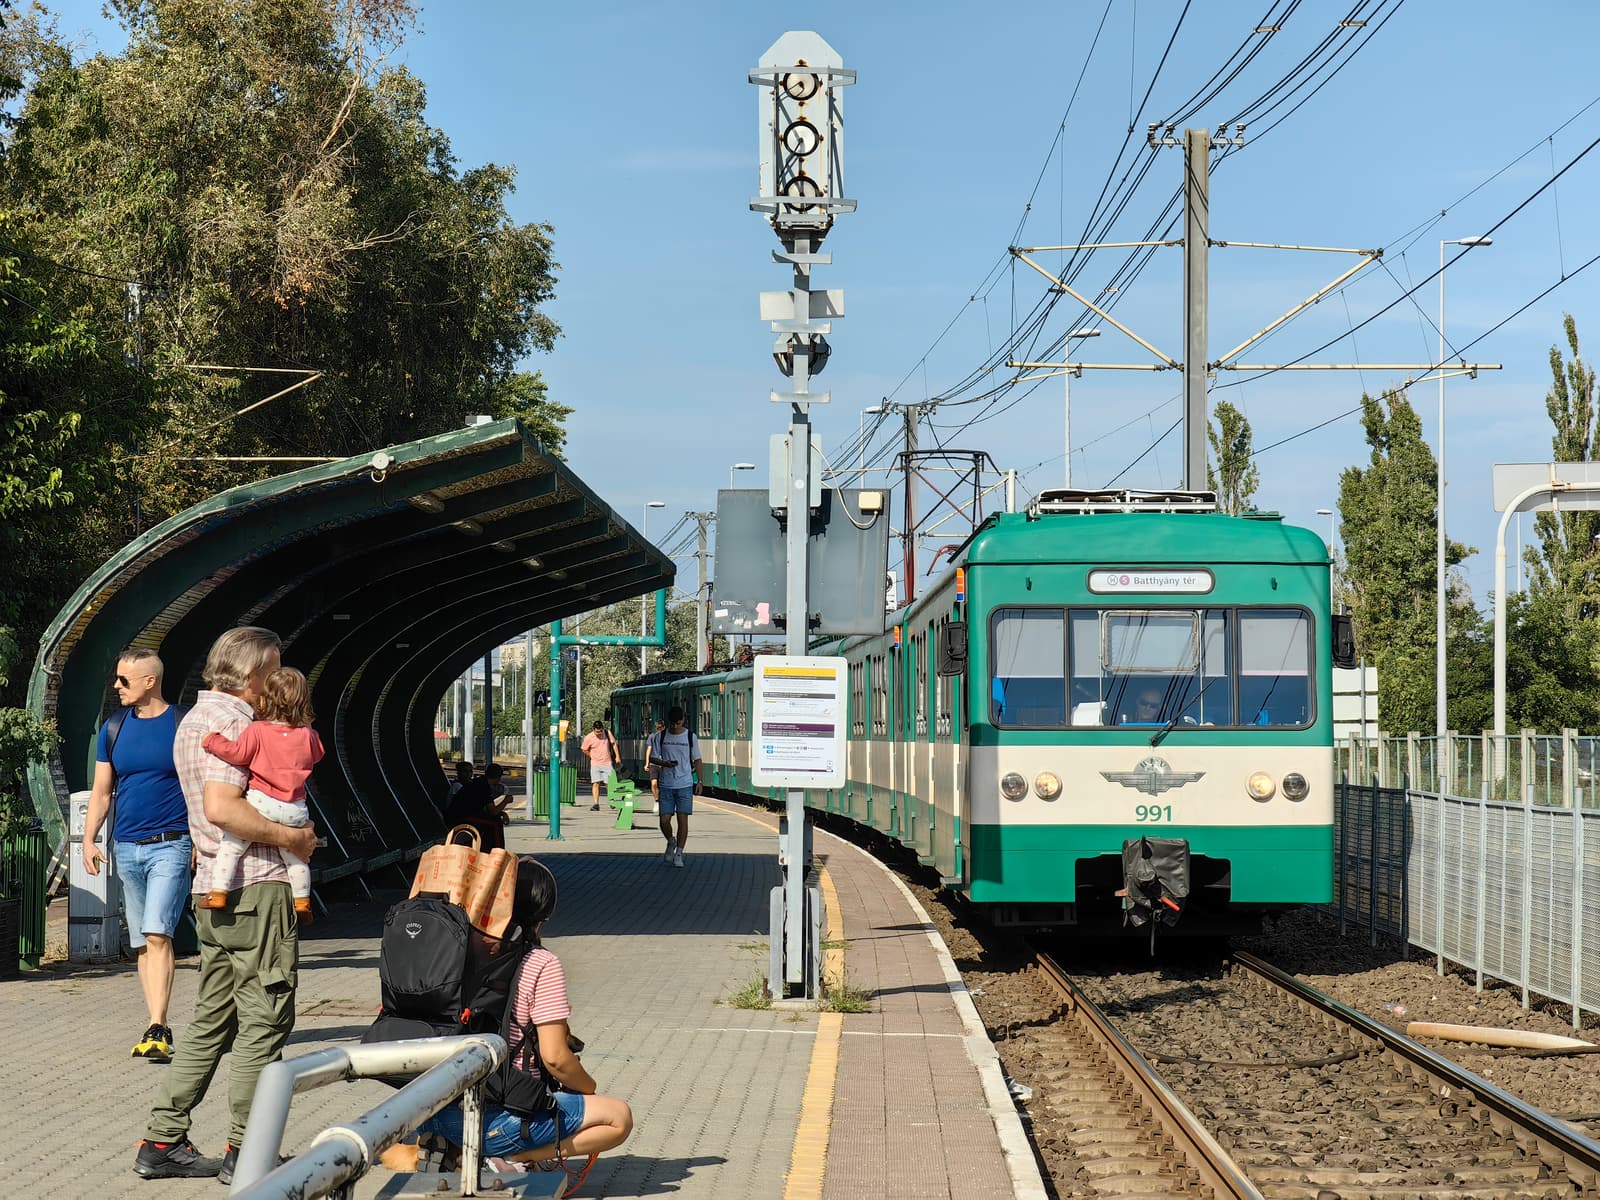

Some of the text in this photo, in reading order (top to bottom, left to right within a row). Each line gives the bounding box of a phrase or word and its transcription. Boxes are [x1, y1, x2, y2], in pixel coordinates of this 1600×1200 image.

[1134, 576, 1180, 586] Batthyány
[1183, 576, 1196, 585] tér
[1135, 805, 1172, 822] 991
